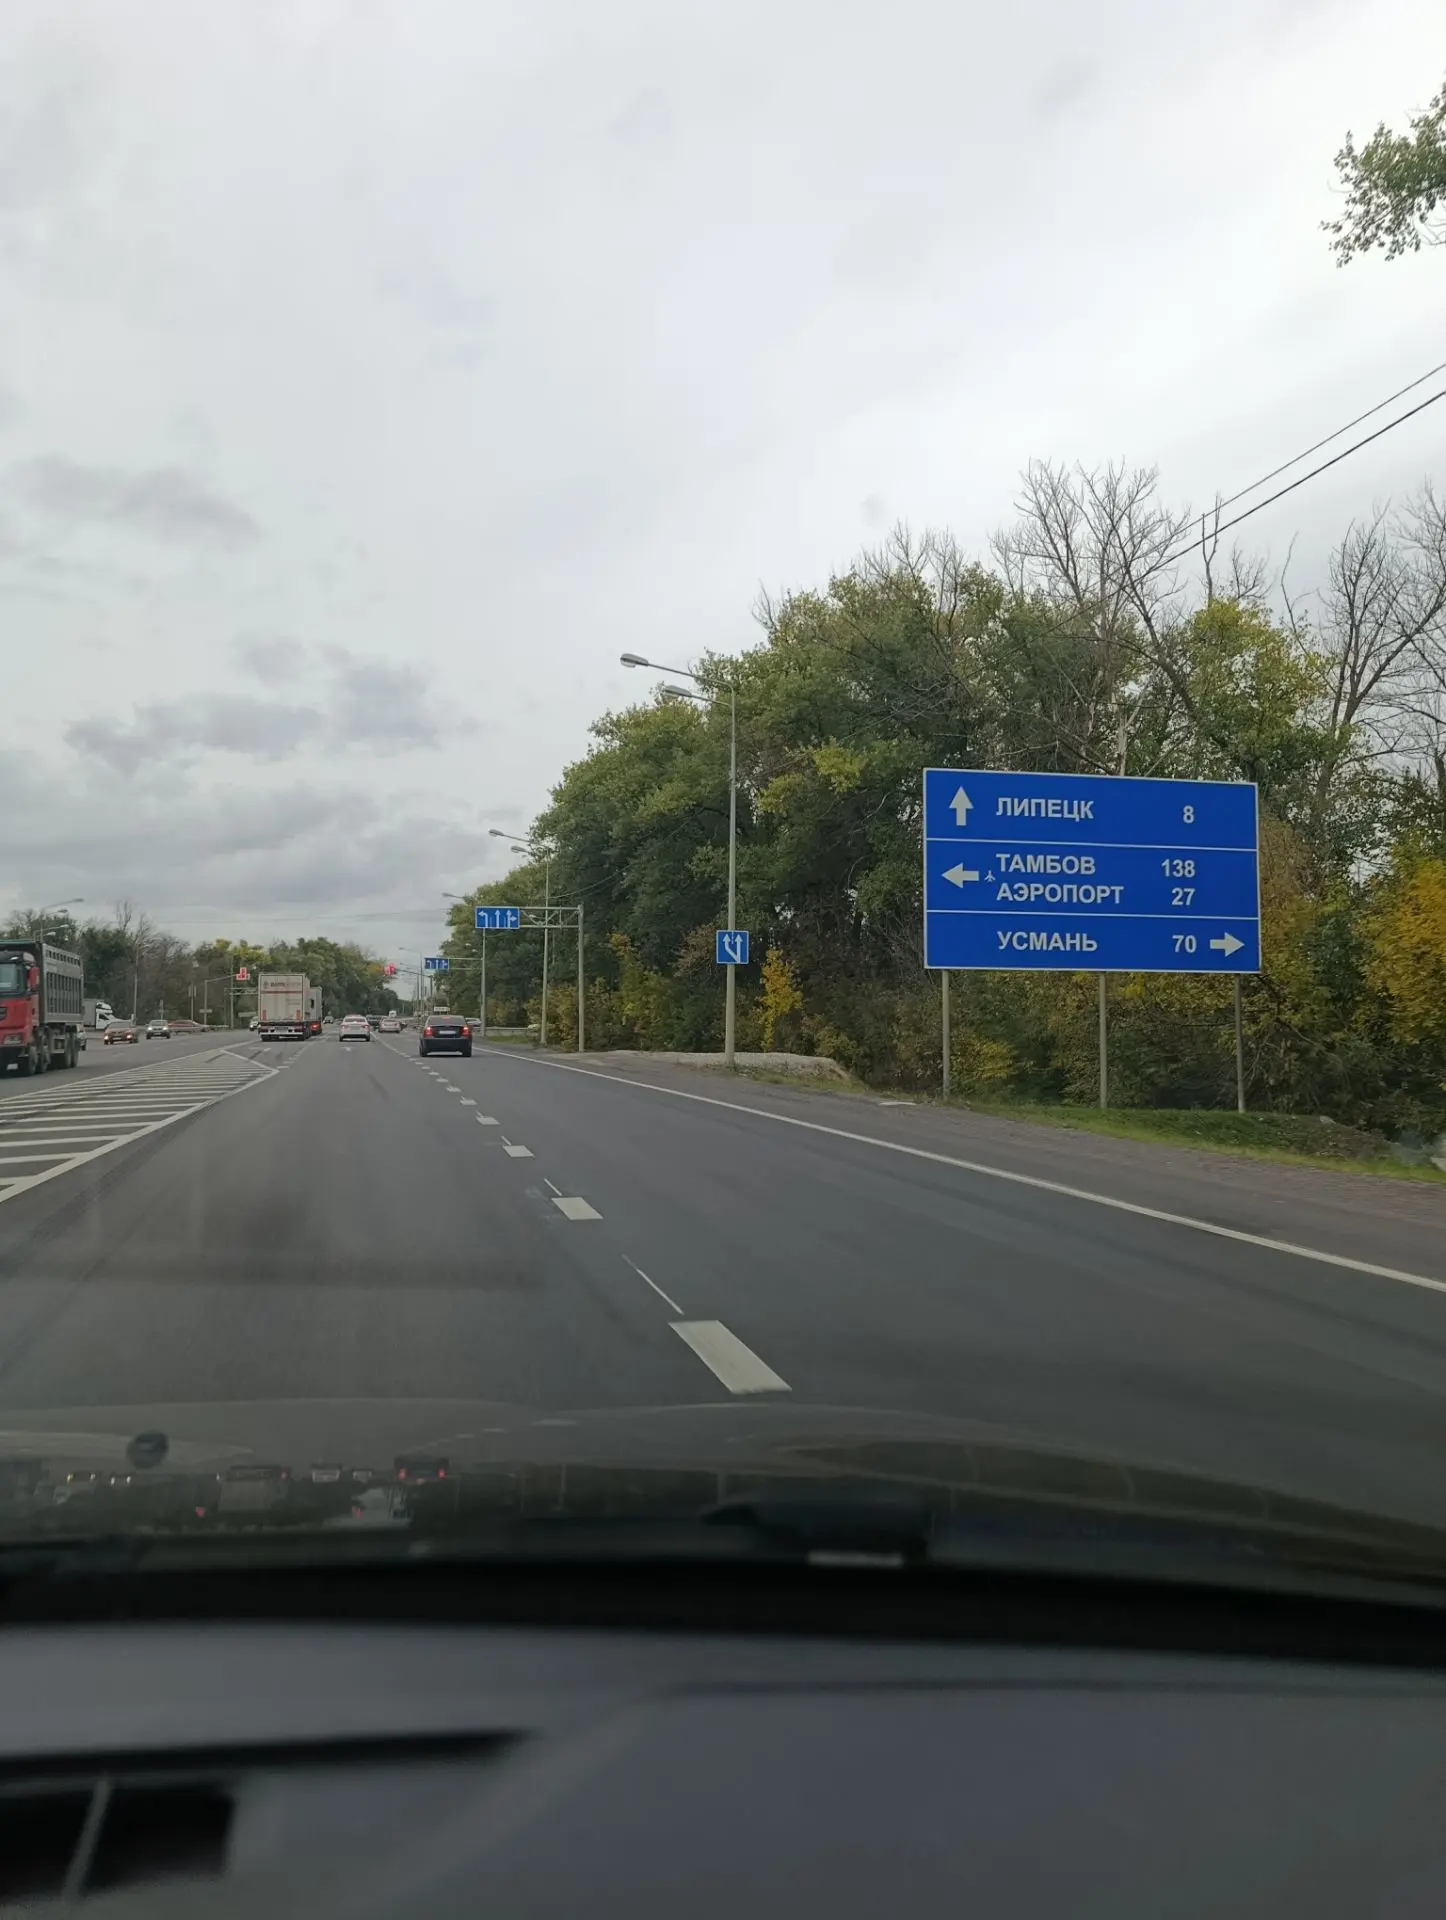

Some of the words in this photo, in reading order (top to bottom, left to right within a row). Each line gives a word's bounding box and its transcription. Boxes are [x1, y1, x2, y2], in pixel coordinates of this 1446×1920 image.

[995, 797, 1094, 822] ЛИПЕЦК
[1183, 805, 1195, 824] 8
[995, 853, 1096, 875] ТАМБОВ
[1161, 859, 1196, 878] 138
[996, 882, 1124, 904] АЭРОПОРТ
[1171, 887, 1195, 906] 27
[997, 931, 1098, 952] УСМАНЬ
[1172, 934, 1197, 954] 70
